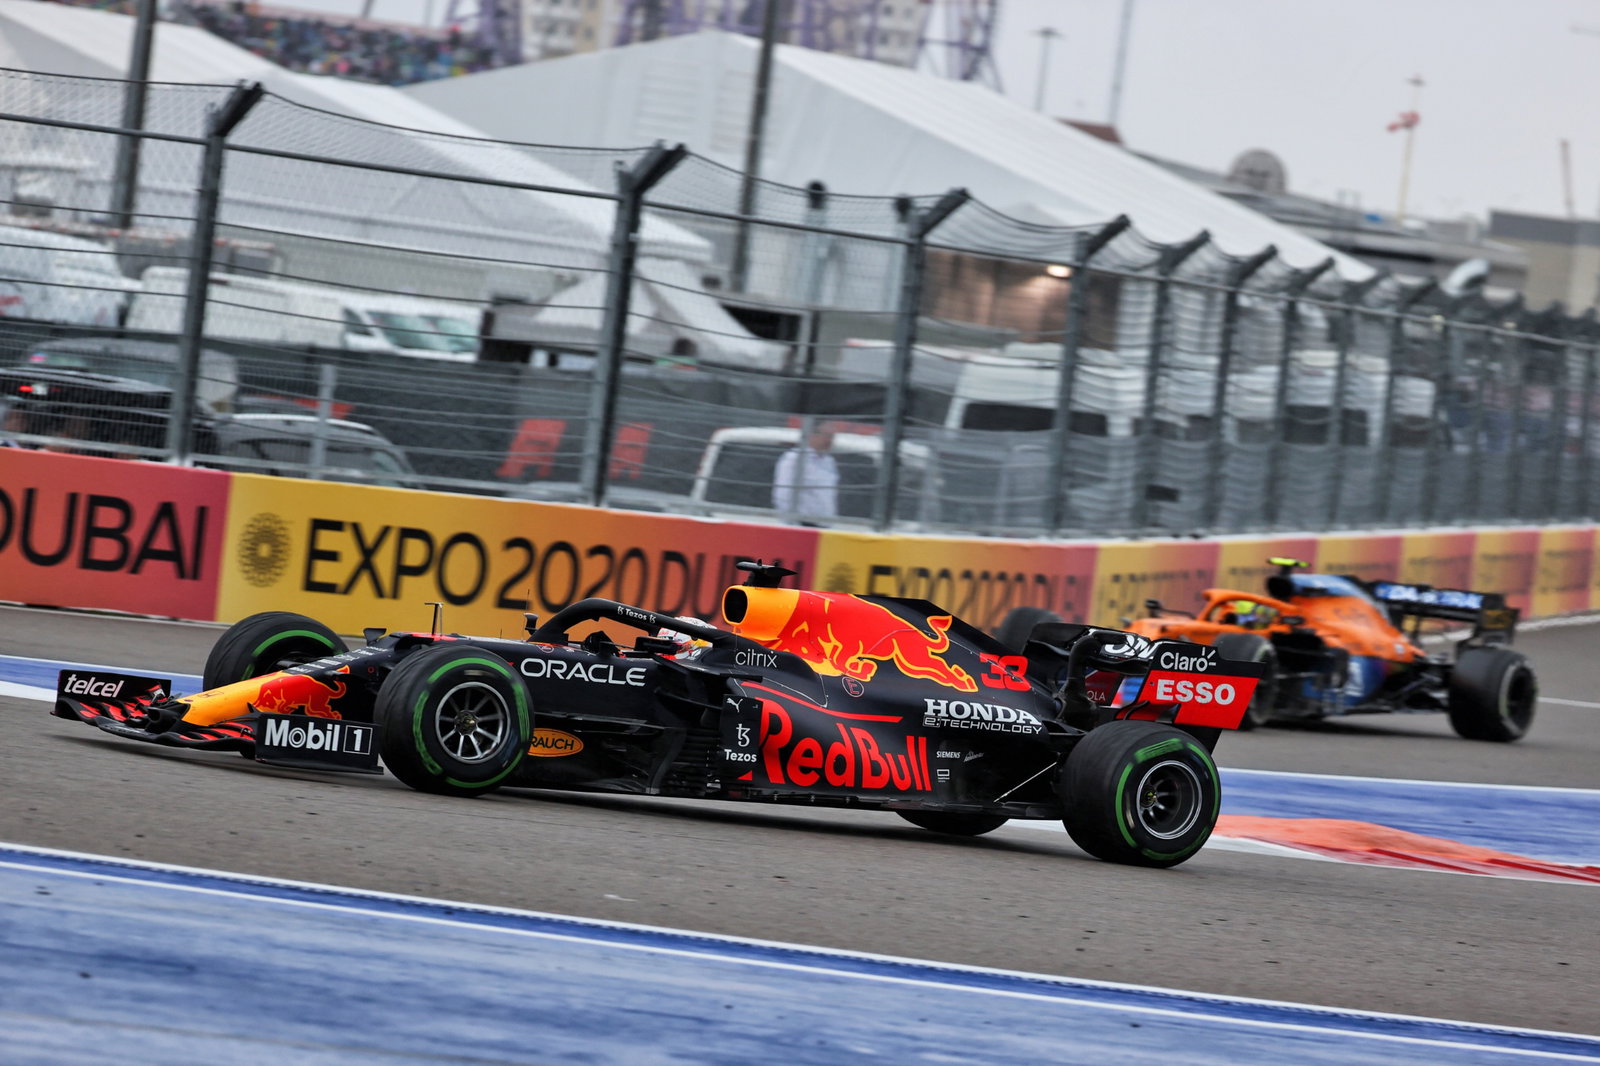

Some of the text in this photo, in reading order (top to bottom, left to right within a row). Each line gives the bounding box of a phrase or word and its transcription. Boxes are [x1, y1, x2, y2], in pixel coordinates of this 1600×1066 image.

[0, 486, 210, 581] UBAI
[302, 518, 489, 607] EXPO
[494, 536, 650, 614] 2020
[625, 608, 647, 621] Tezos
[735, 648, 778, 669] citrix
[1160, 650, 1209, 672] Claro
[520, 657, 647, 687] ORACLE
[979, 652, 1032, 692] 33
[63, 673, 124, 698] telcel
[1156, 678, 1236, 705] ESSO
[924, 698, 1042, 726] HONDA
[264, 718, 341, 751] Mobil
[530, 735, 575, 750] RAUCH
[724, 748, 757, 763] Tezos
[936, 750, 961, 759] SIEMENS
